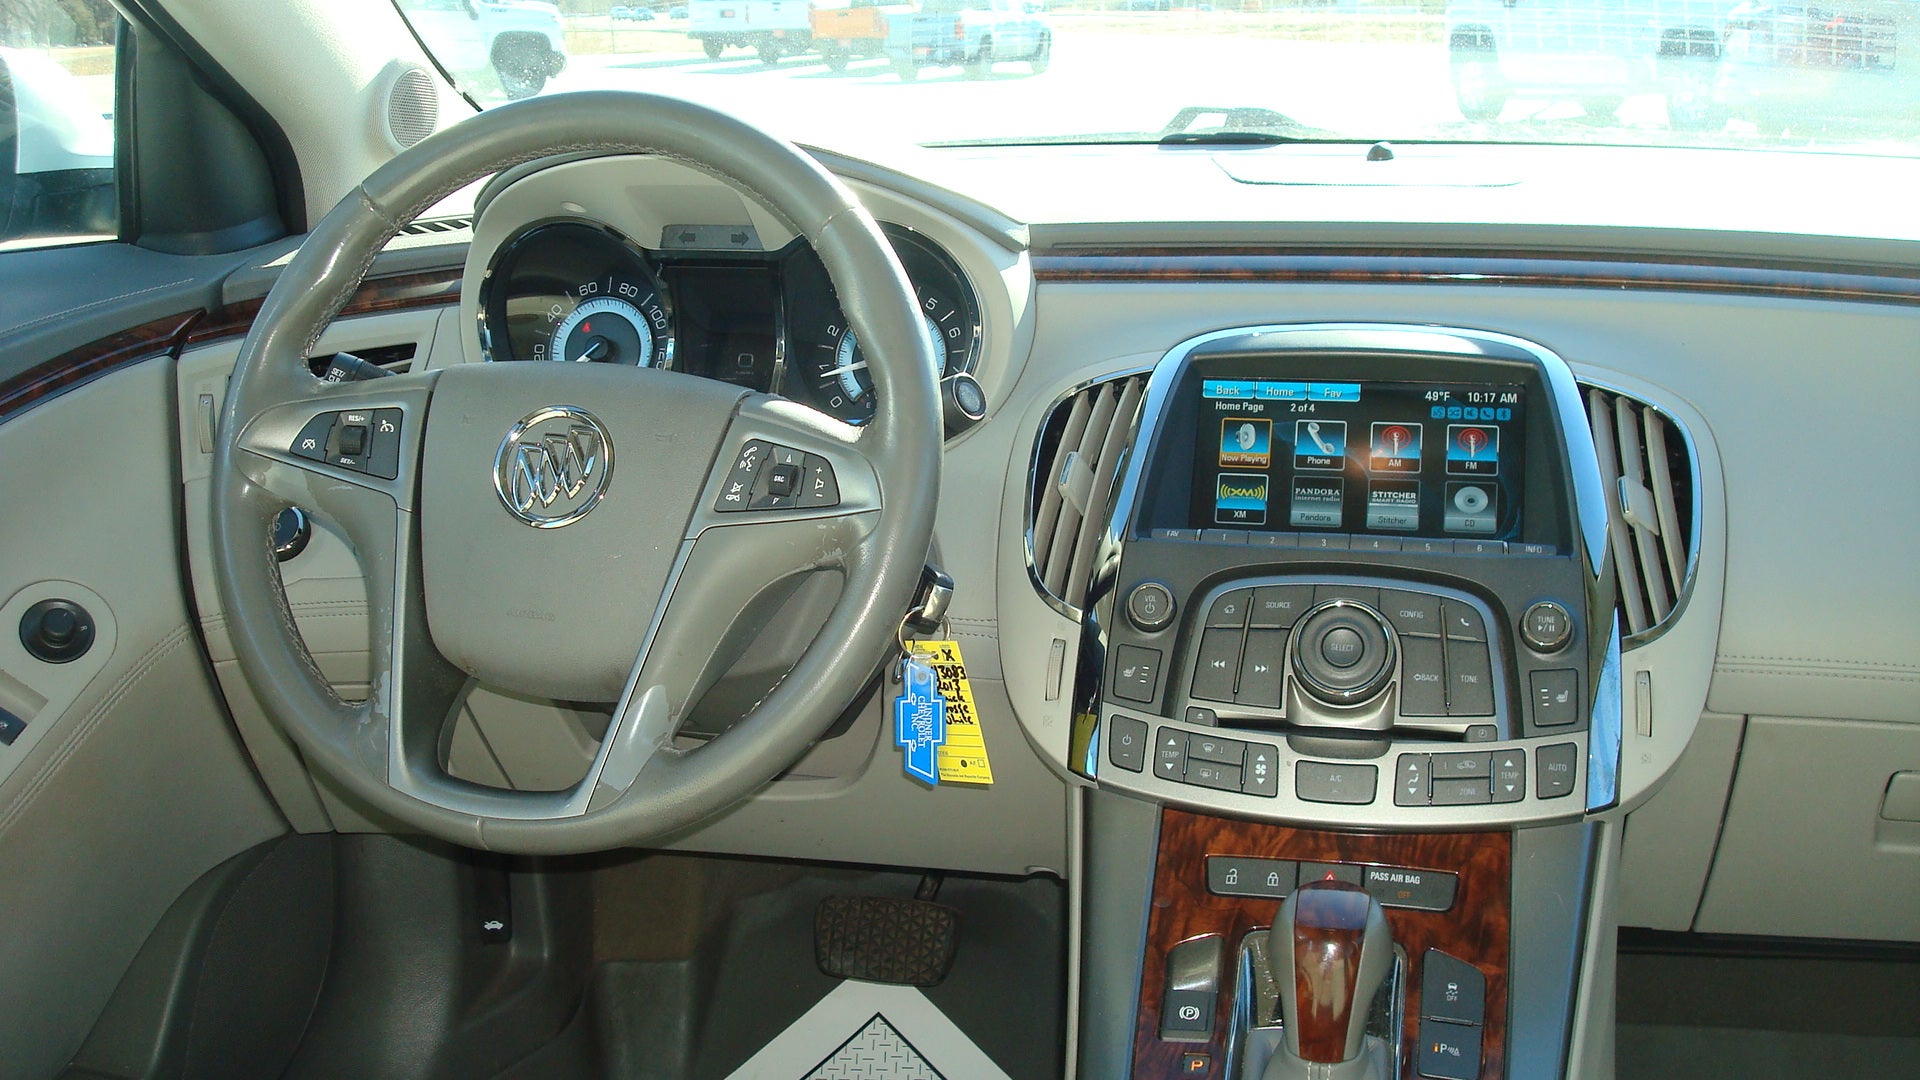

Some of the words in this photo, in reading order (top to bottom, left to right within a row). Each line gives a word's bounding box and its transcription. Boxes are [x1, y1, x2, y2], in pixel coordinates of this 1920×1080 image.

[578, 281, 598, 296] 60
[618, 282, 638, 298] 80
[925, 297, 938, 310] 5
[546, 304, 563, 323] 40
[650, 304, 666, 330] 100
[827, 325, 840, 337] 2
[948, 327, 961, 338] 6
[818, 363, 830, 371] 1
[1216, 385, 1240, 396] Back
[1266, 387, 1294, 397] Home
[1324, 388, 1342, 398] Fav
[1425, 391, 1450, 402] 49°F
[1467, 392, 1496, 403] 10:17
[1500, 393, 1518, 404] AM
[830, 396, 843, 408] 0
[1215, 401, 1241, 411] Home
[1242, 402, 1264, 413] Page
[1290, 404, 1297, 412] 2
[1298, 404, 1308, 412] of
[1309, 404, 1316, 413] 4
[1221, 453, 1239, 462] Now
[1240, 454, 1267, 464] Playing
[1307, 456, 1331, 465] Phone
[1388, 459, 1402, 467] AM
[1465, 461, 1478, 470] FM
[1295, 487, 1340, 496] PANDORA
[1372, 491, 1417, 499] STITCHER
[1233, 510, 1247, 518] XM
[1300, 513, 1331, 521] Pandora
[1378, 515, 1407, 524] Stitcher
[1464, 519, 1475, 528] CD
[1270, 536, 1275, 544] 2
[1321, 539, 1327, 547] 3
[1425, 543, 1431, 551] 5
[1525, 546, 1543, 554] INFO
[1400, 610, 1424, 619] CONFIG
[1537, 615, 1555, 624] TUNE
[1330, 643, 1354, 651] SELECT
[1420, 674, 1439, 682] BACK
[1460, 675, 1478, 683] TONE
[917, 695, 926, 748] CHEVROLET
[925, 702, 933, 742] LINDNER
[1161, 750, 1180, 759] TEMP
[1548, 763, 1567, 772] AUTO
[1329, 774, 1343, 782] A/C
[1501, 771, 1520, 779] TEMP
[1370, 871, 1389, 881] PASS
[1390, 873, 1404, 883] AIR
[1405, 875, 1421, 885] BAG
[1190, 1060, 1204, 1072] P
